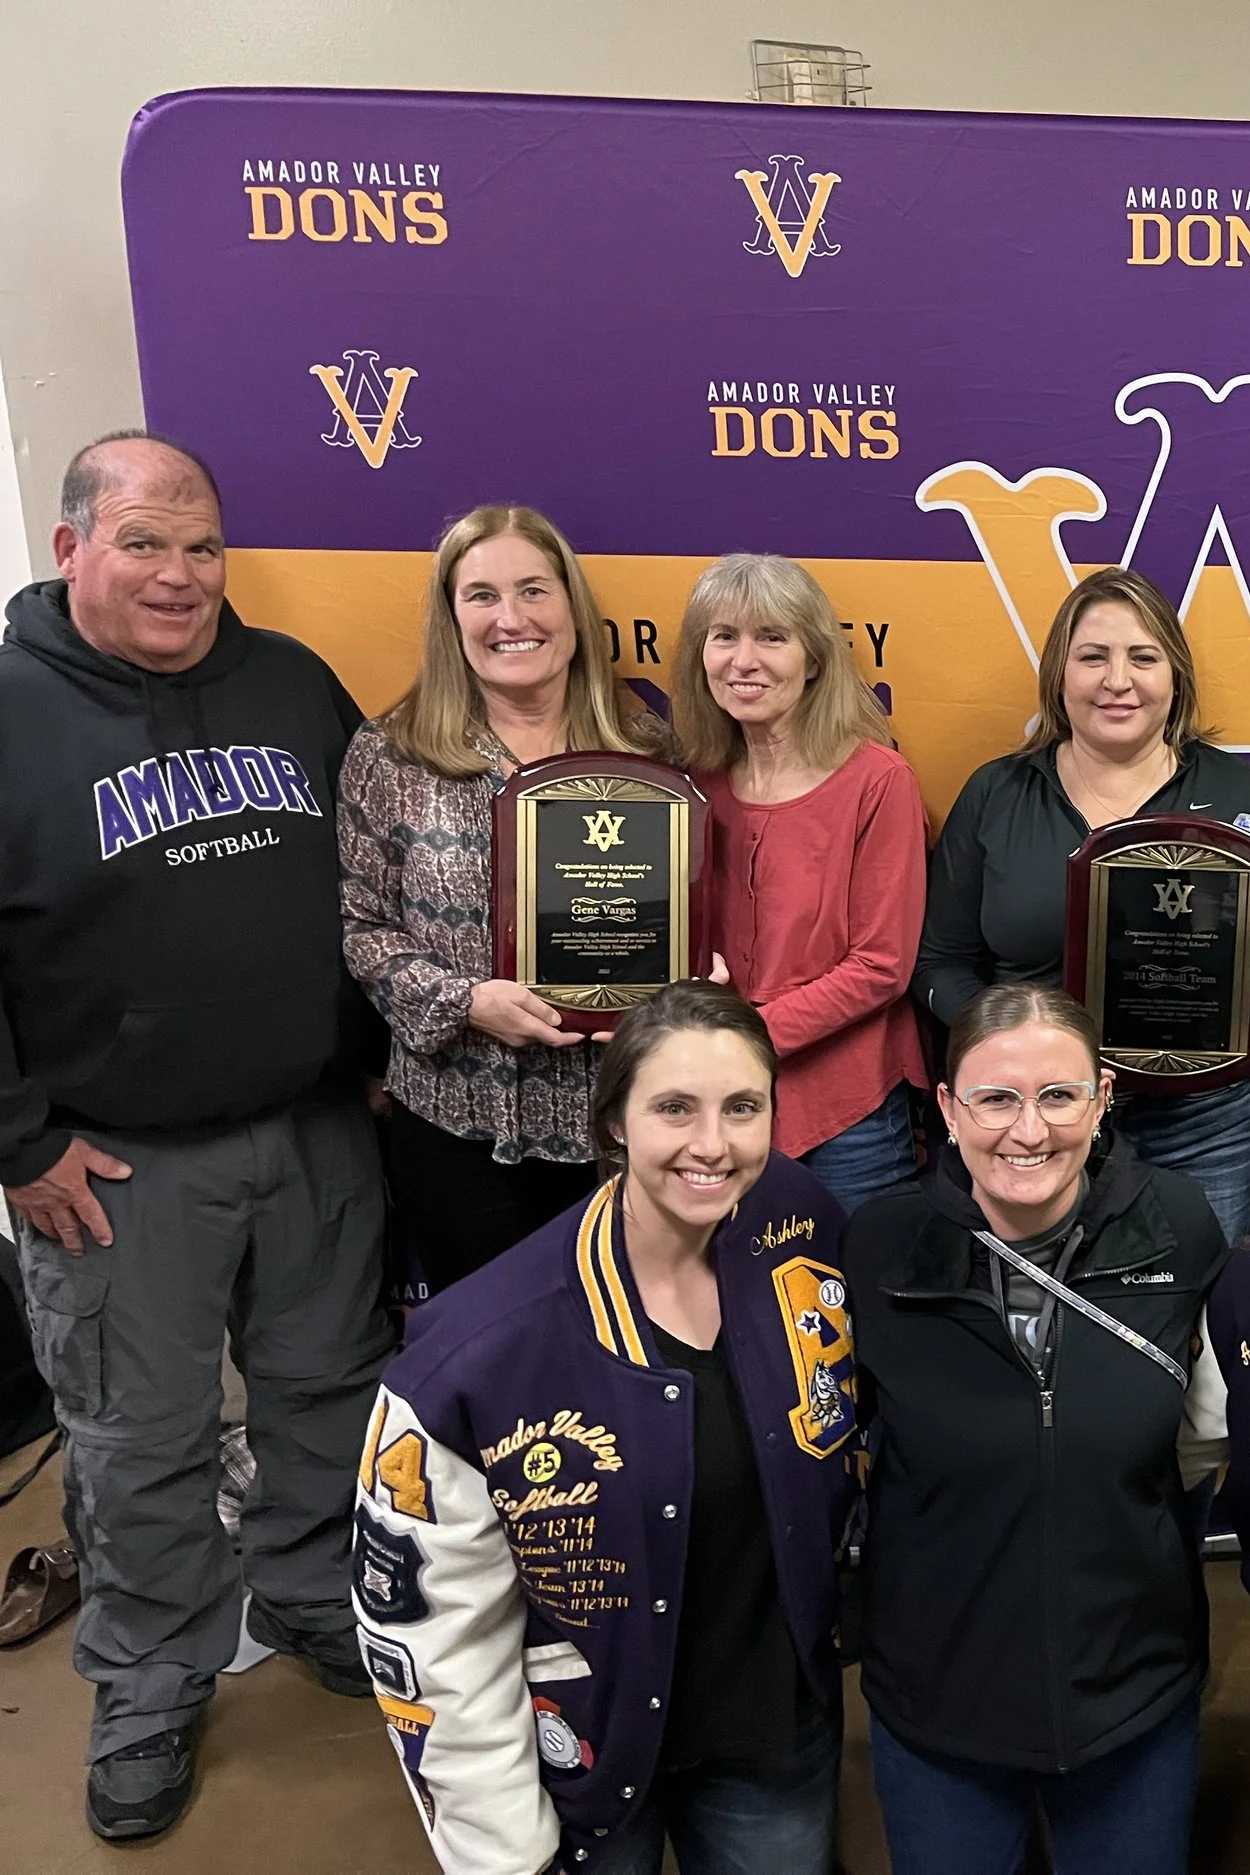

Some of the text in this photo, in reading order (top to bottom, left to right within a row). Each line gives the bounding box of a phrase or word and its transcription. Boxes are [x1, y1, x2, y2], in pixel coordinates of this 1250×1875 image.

[242, 159, 440, 187] AMADOR VALLEY
[1126, 187, 1219, 210] AMADOR
[244, 186, 448, 245] DONS
[707, 381, 896, 406] AMADOR VALLEY
[708, 406, 900, 460] DONS
[94, 745, 323, 861] AMADOR
[165, 828, 280, 866] SOFTBALL
[571, 905, 636, 916] Gene Vargas
[1122, 970, 1217, 984] 2014 Softball Team
[750, 1214, 815, 1256] Ashley
[1131, 1271, 1175, 1284] Columbia
[479, 1409, 625, 1472] mador Valley
[527, 1451, 556, 1478] #5
[491, 1481, 599, 1521] Softball
